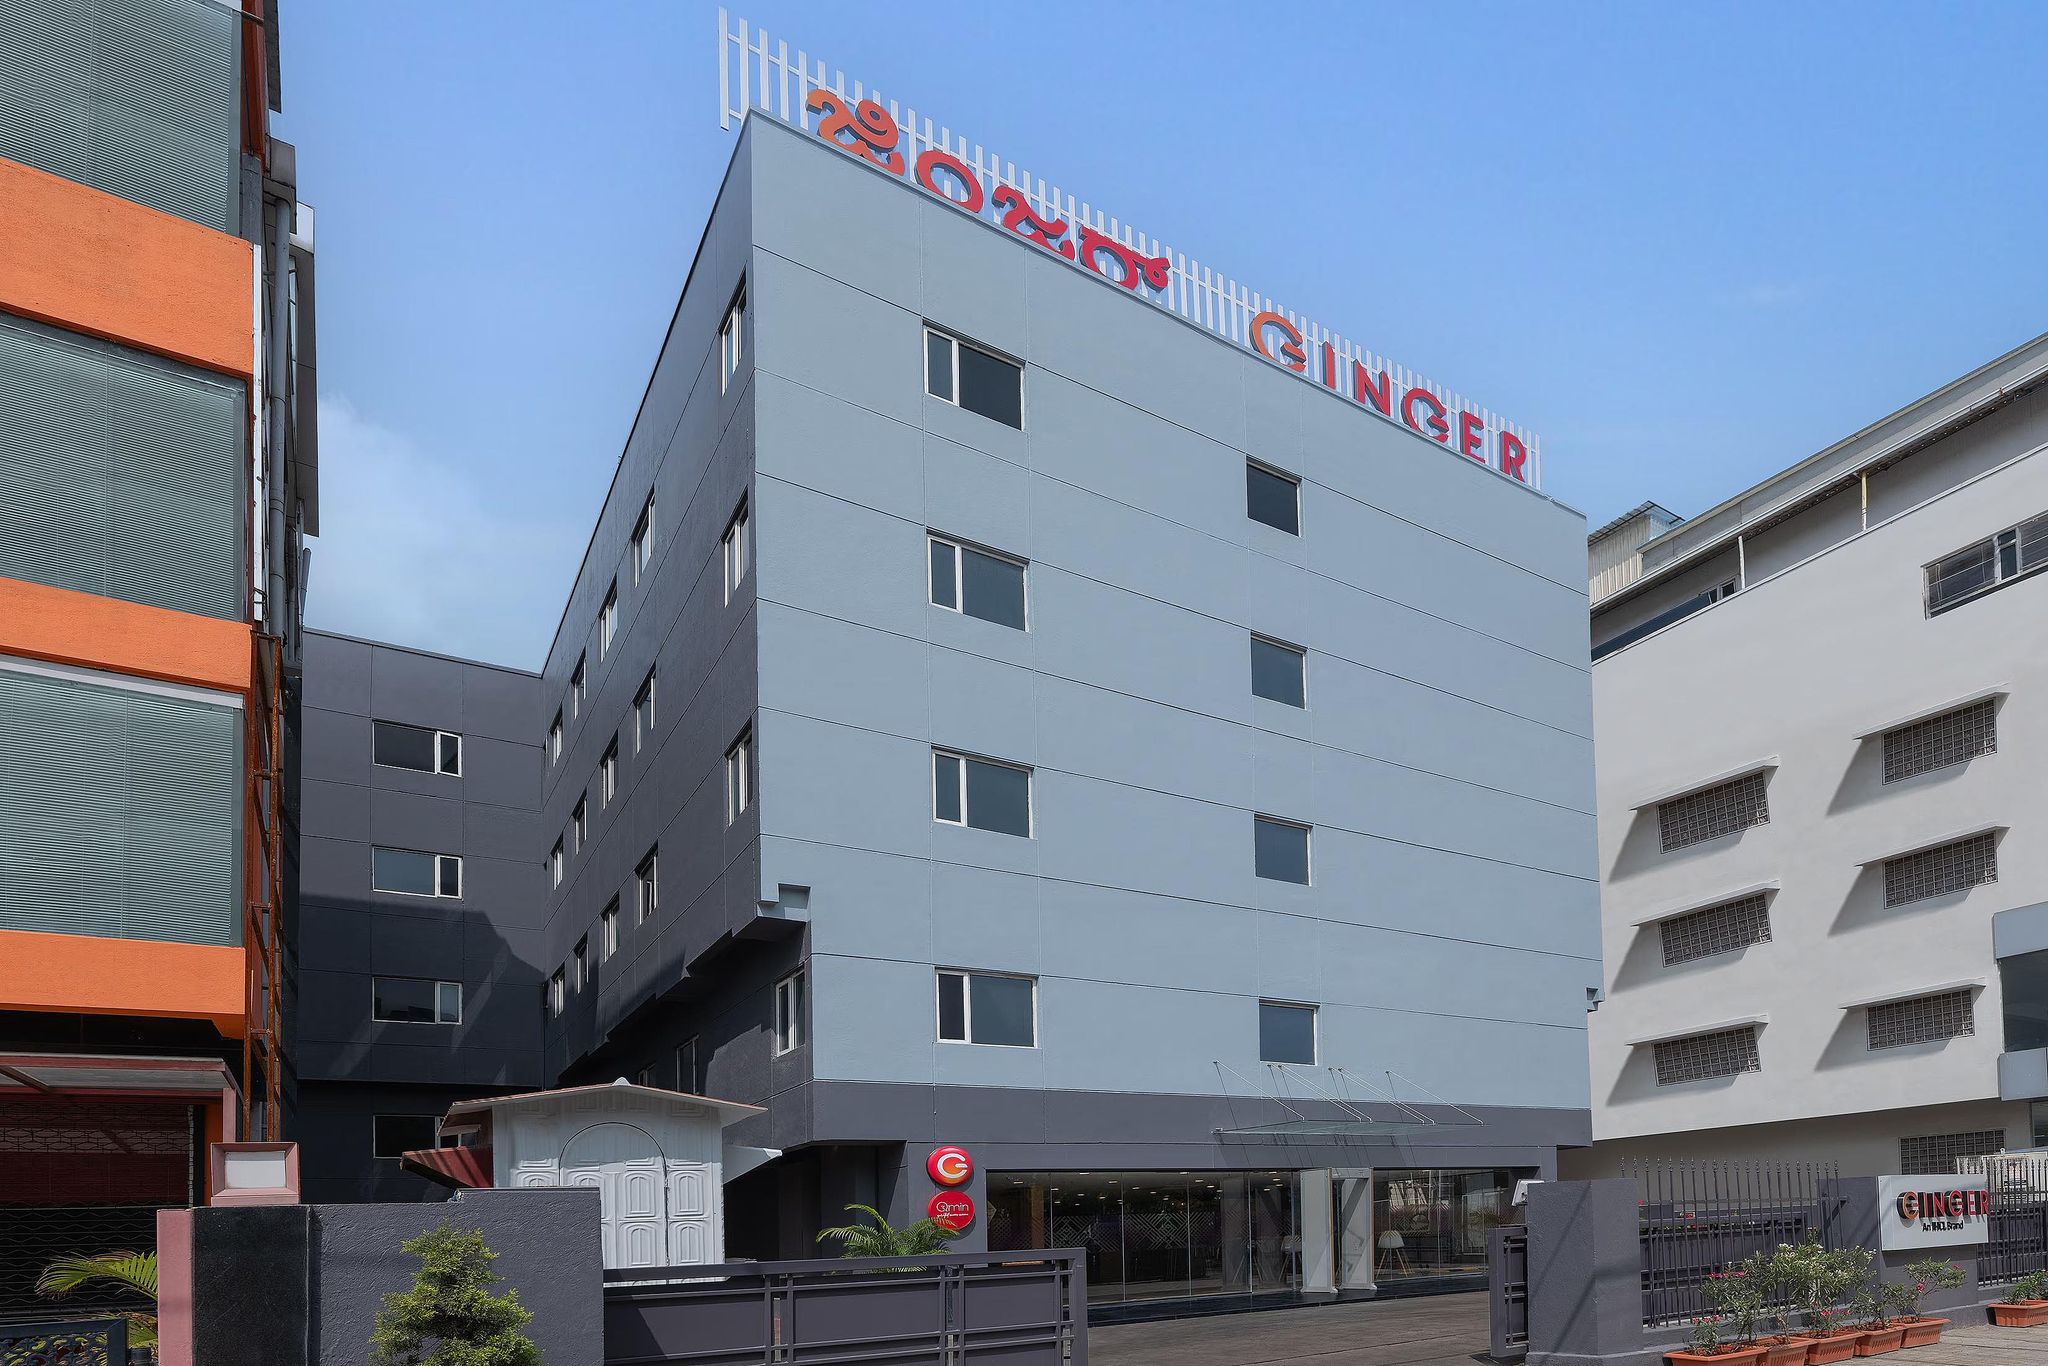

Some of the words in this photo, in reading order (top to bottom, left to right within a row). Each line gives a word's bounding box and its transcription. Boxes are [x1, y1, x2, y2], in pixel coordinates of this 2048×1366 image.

[806, 88, 1170, 291] ಜಿಂಜರ್
[1249, 311, 1526, 483] GINGER
[1897, 1190, 1989, 1220] GINGER
[1922, 1222, 1931, 1232] An
[1946, 1220, 1964, 1230] Brand
